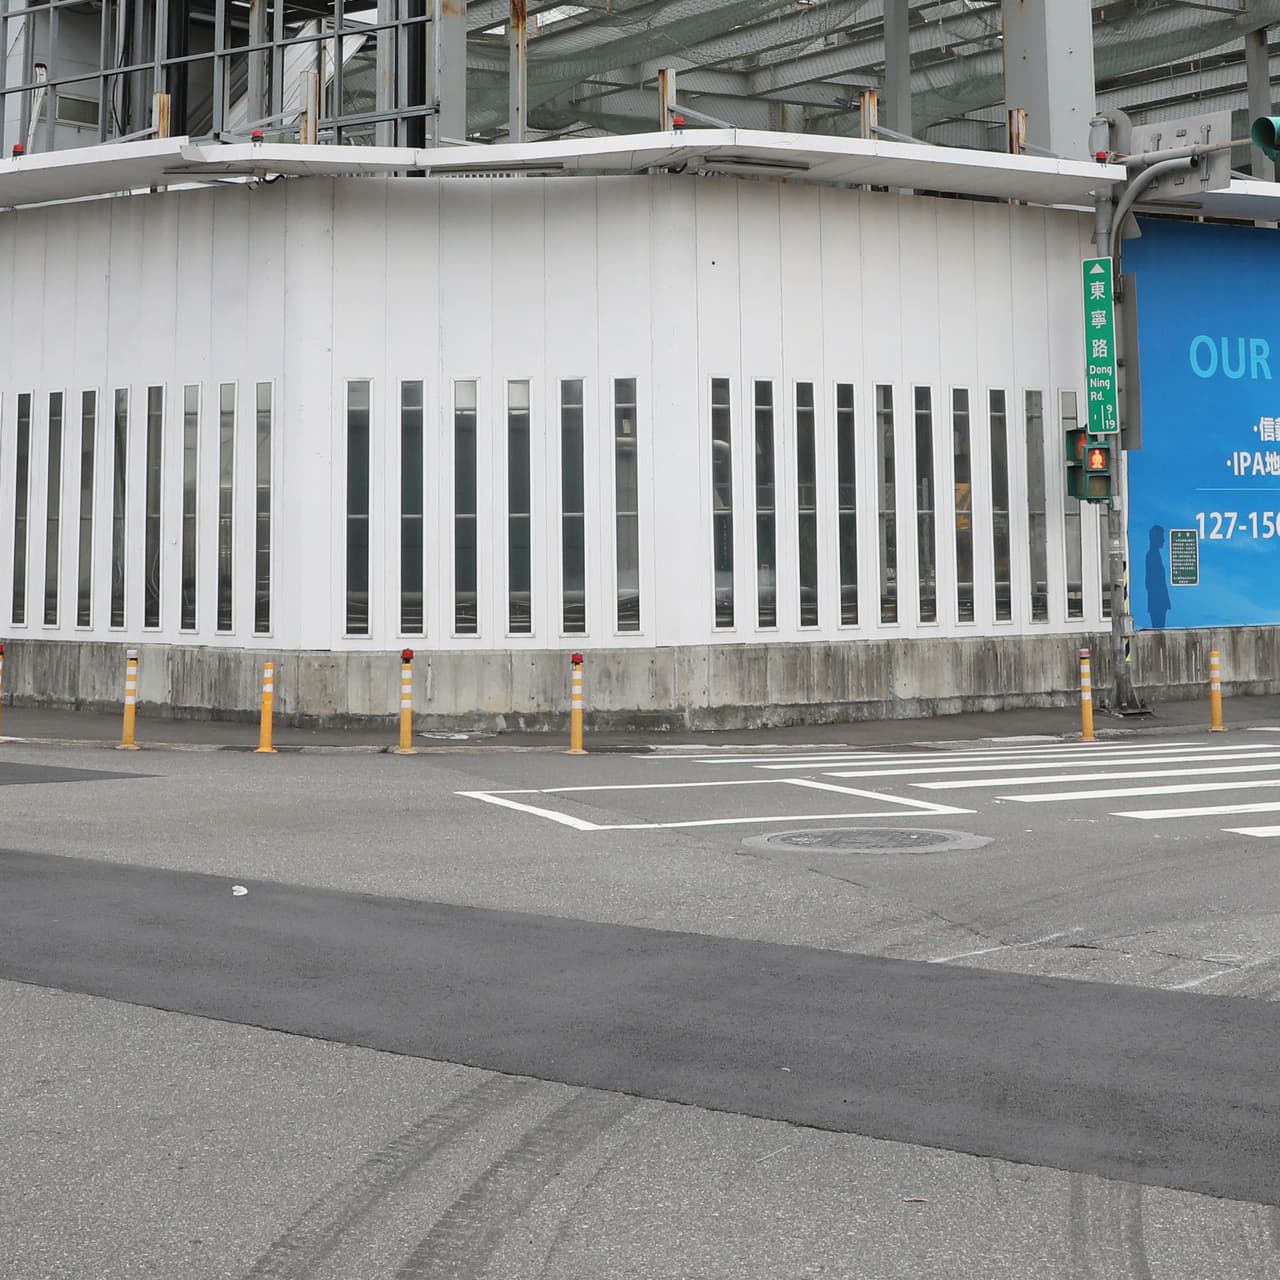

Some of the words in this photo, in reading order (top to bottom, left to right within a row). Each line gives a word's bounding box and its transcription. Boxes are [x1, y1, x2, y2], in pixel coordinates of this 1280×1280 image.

[1089, 280, 1108, 358] 東寧路
[1189, 334, 1272, 381] OUR
[1089, 365, 1112, 376] Dong
[1090, 378, 1111, 390] Ning
[1090, 391, 1104, 401] Rd.
